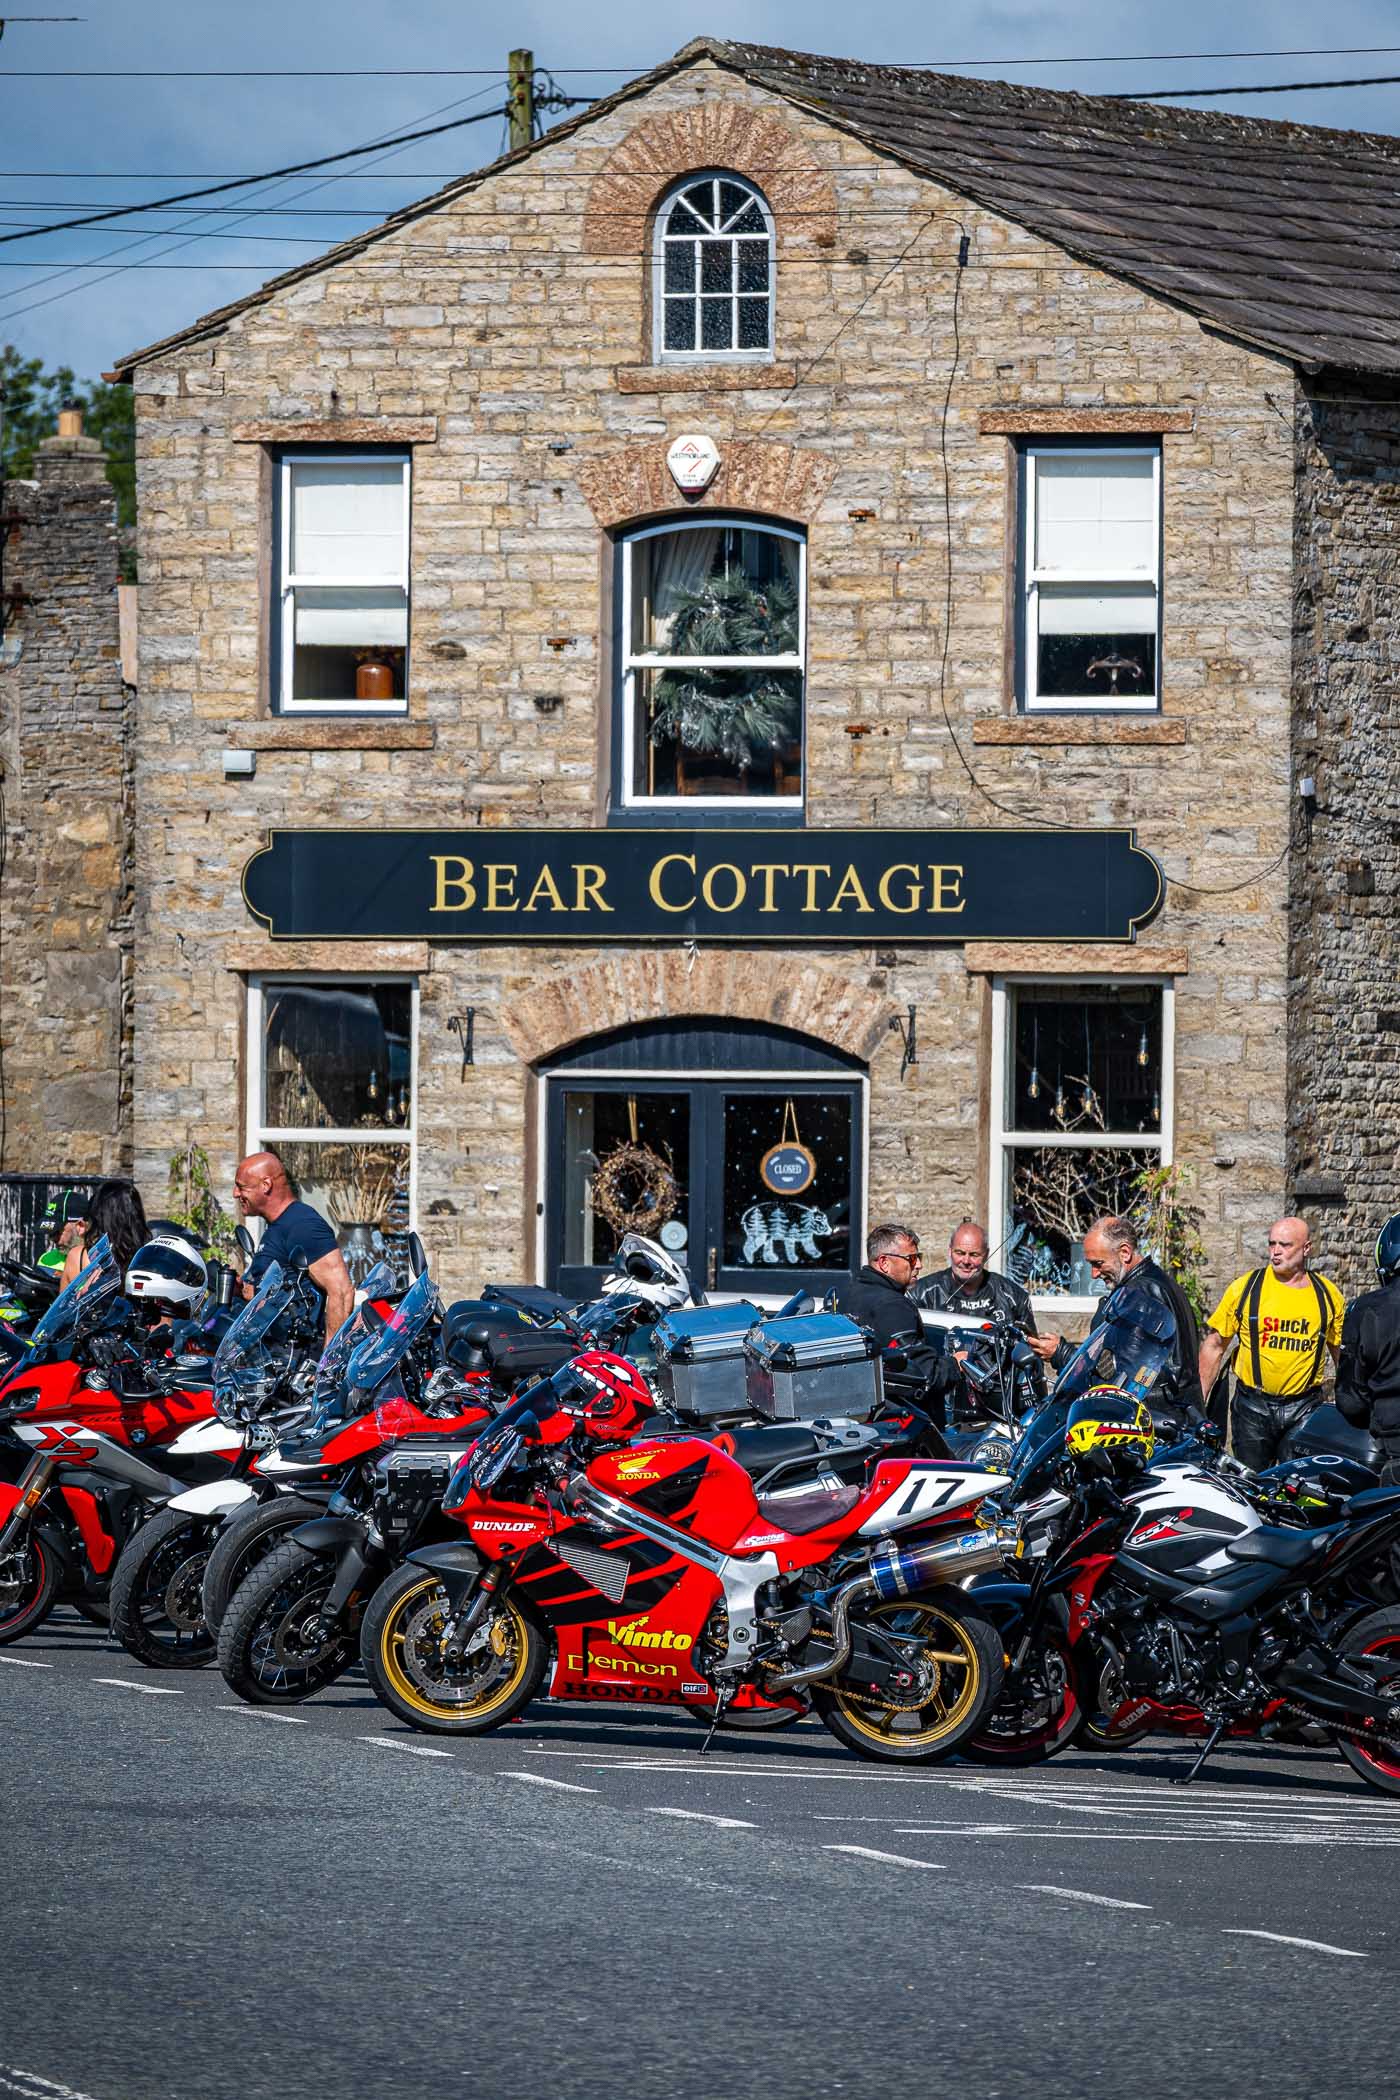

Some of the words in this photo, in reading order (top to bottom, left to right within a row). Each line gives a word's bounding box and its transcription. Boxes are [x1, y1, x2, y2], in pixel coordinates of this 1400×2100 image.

[429, 855, 615, 912] BEAR
[649, 853, 966, 913] COTTAGE
[774, 1164, 802, 1175] CLOSED
[1263, 1317, 1310, 1335] Stuck
[1261, 1332, 1315, 1352] Farmer
[33, 1425, 100, 1469] XR
[610, 1448, 668, 1462] Demon
[615, 1471, 661, 1481] HONDA
[896, 1477, 967, 1517] 17
[471, 1520, 535, 1532] DUNLOP
[607, 1616, 693, 1651] Vimto
[567, 1651, 678, 1677] Demon
[564, 1682, 689, 1702] HONDA
[1118, 1702, 1152, 1729] SUZUKI
